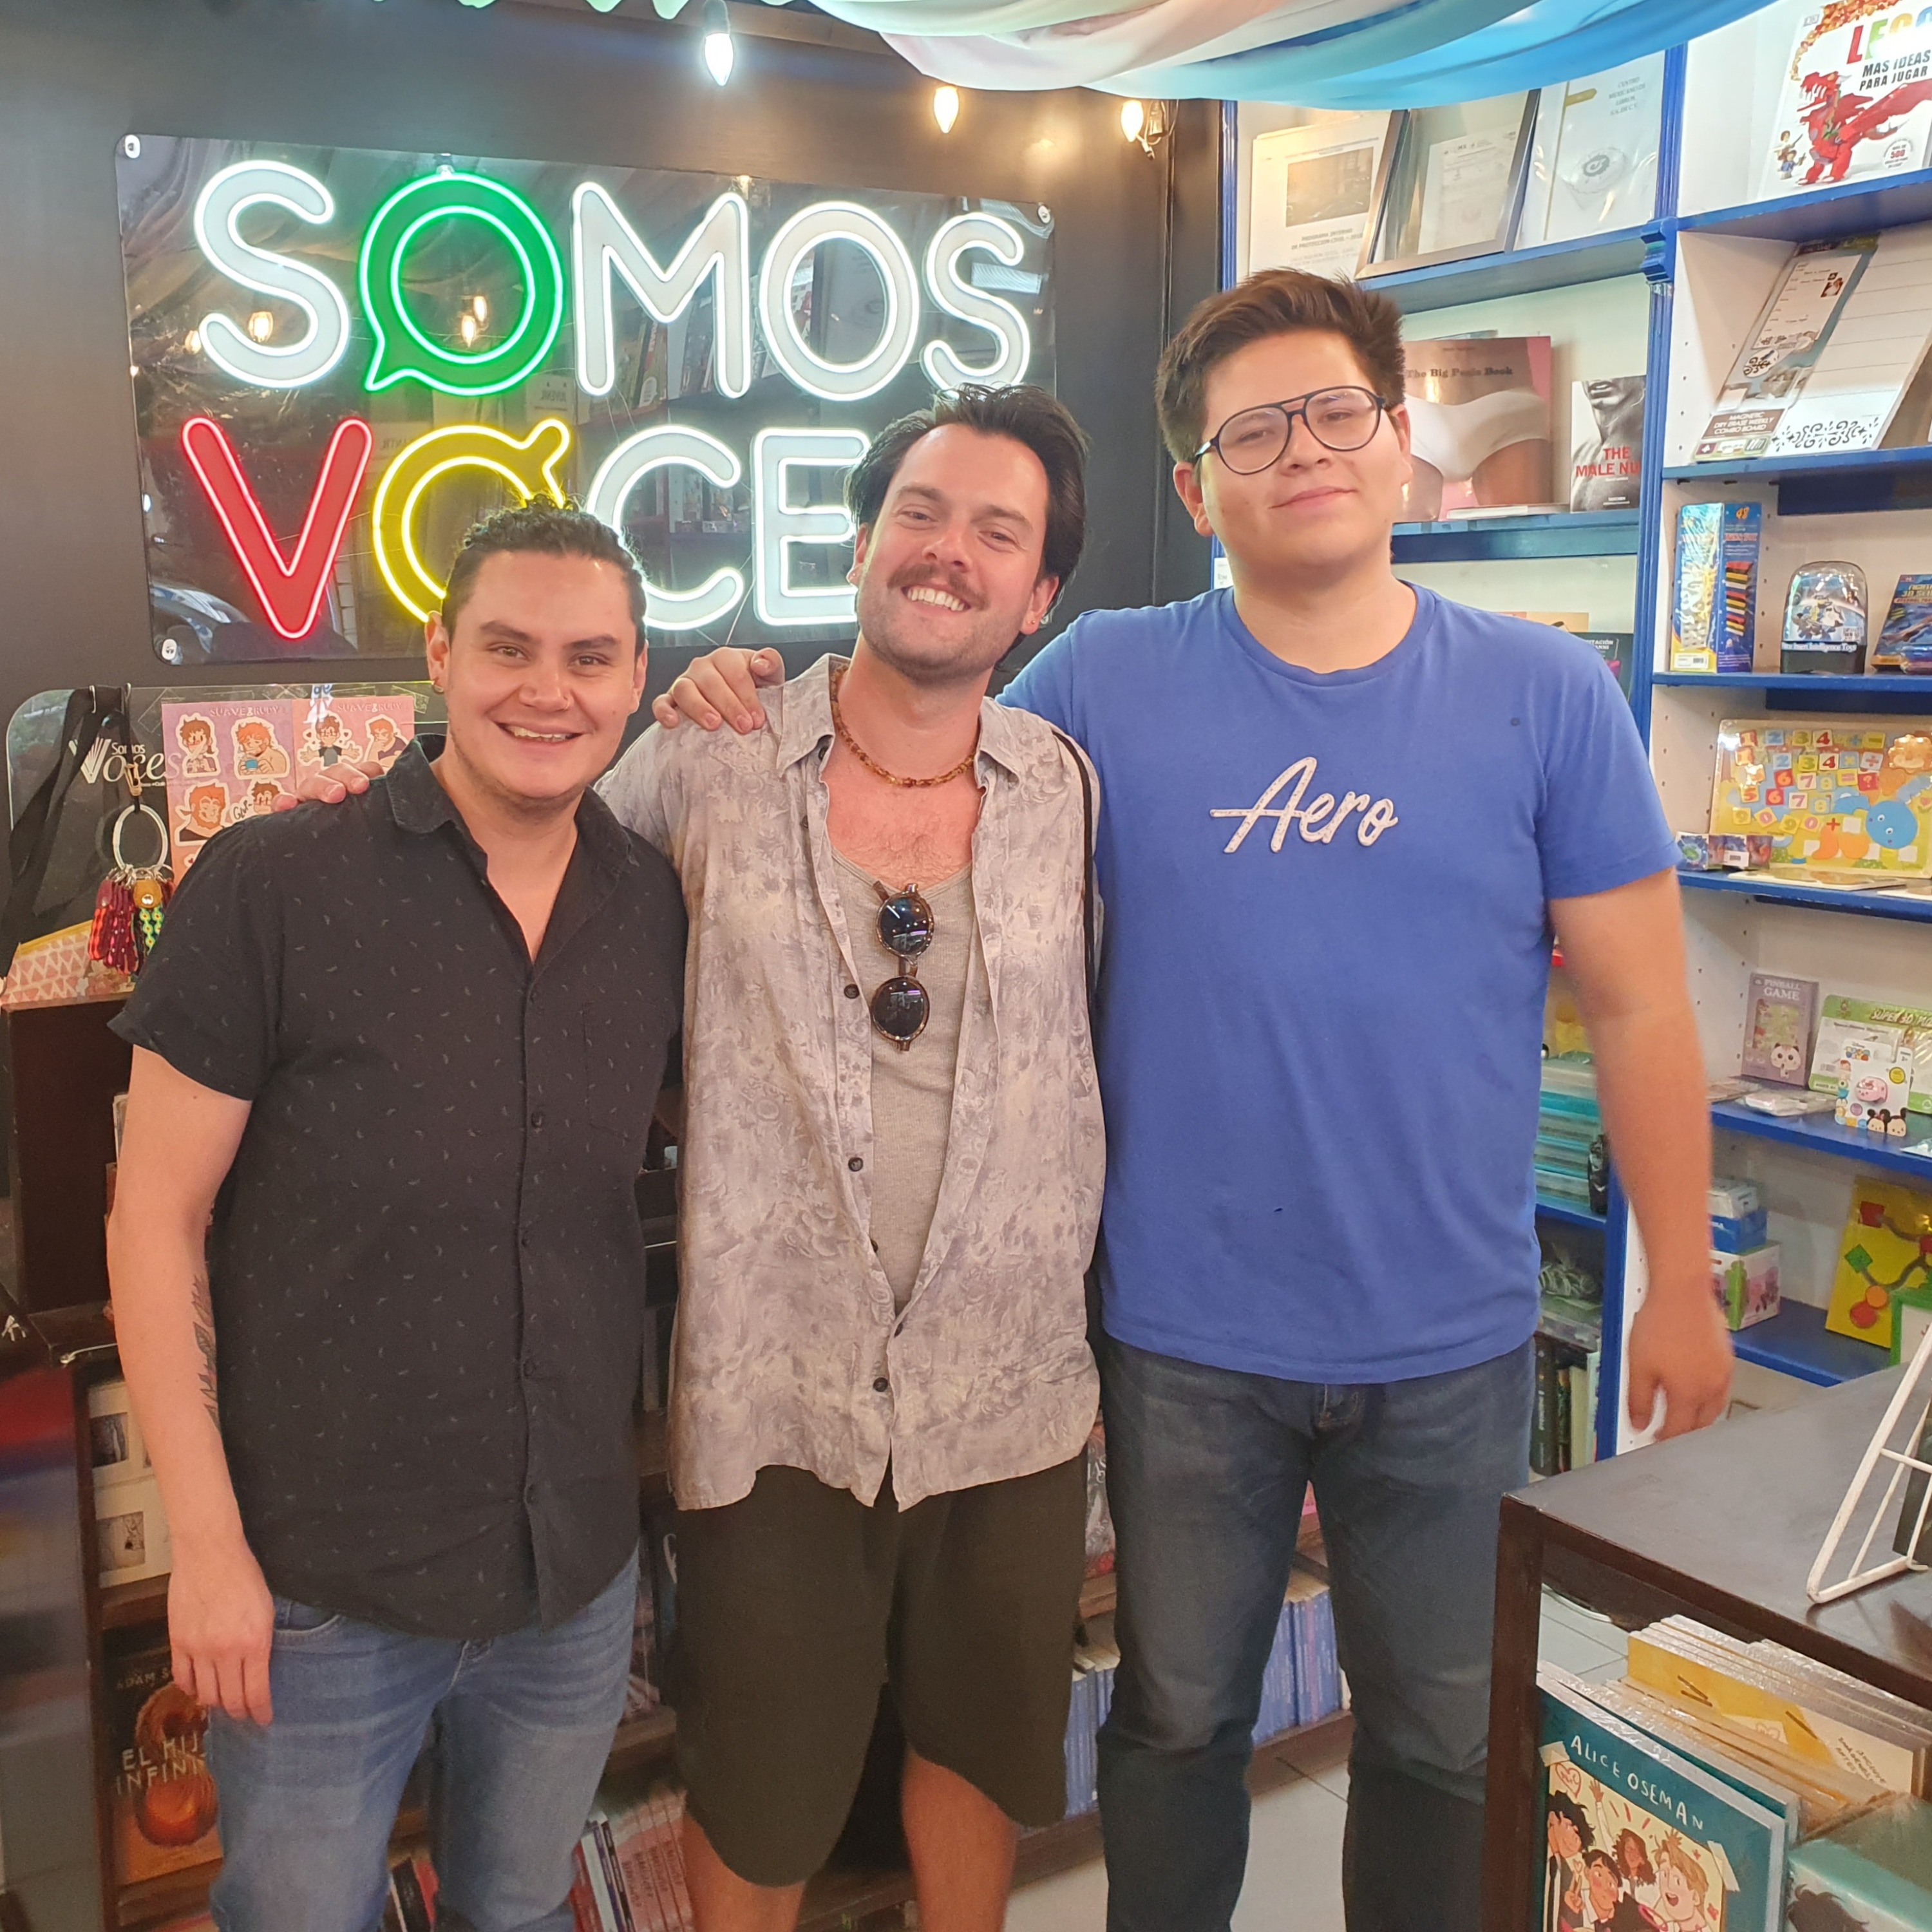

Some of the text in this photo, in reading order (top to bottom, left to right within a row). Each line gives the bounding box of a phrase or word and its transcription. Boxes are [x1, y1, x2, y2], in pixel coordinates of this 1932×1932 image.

[1893, 50, 1931, 70] IDEAS
[1859, 66, 1928, 91] PARA JUGAR
[194, 159, 1032, 402] SOMOS
[1430, 368, 1448, 378] Big
[1603, 445, 1631, 460] THE
[1576, 459, 1641, 478] MALE NU
[181, 416, 872, 639] VOCE
[1817, 732, 1830, 745] 4
[1776, 754, 1790, 768] 2
[1802, 757, 1815, 770] 3
[1822, 755, 1836, 768] 4
[1777, 771, 1792, 786] 6
[1800, 775, 1814, 788] 7
[1209, 757, 1398, 853] Aero
[1768, 790, 1782, 804] 6
[1792, 795, 1806, 807] 7
[1765, 978, 1801, 990] PINBALL
[1763, 987, 1800, 1001] GAME
[122, 1731, 199, 1770] EL HIJ
[116, 1754, 205, 1795] INFINI
[1571, 1735, 1703, 1830] ALICE OSEMAN
